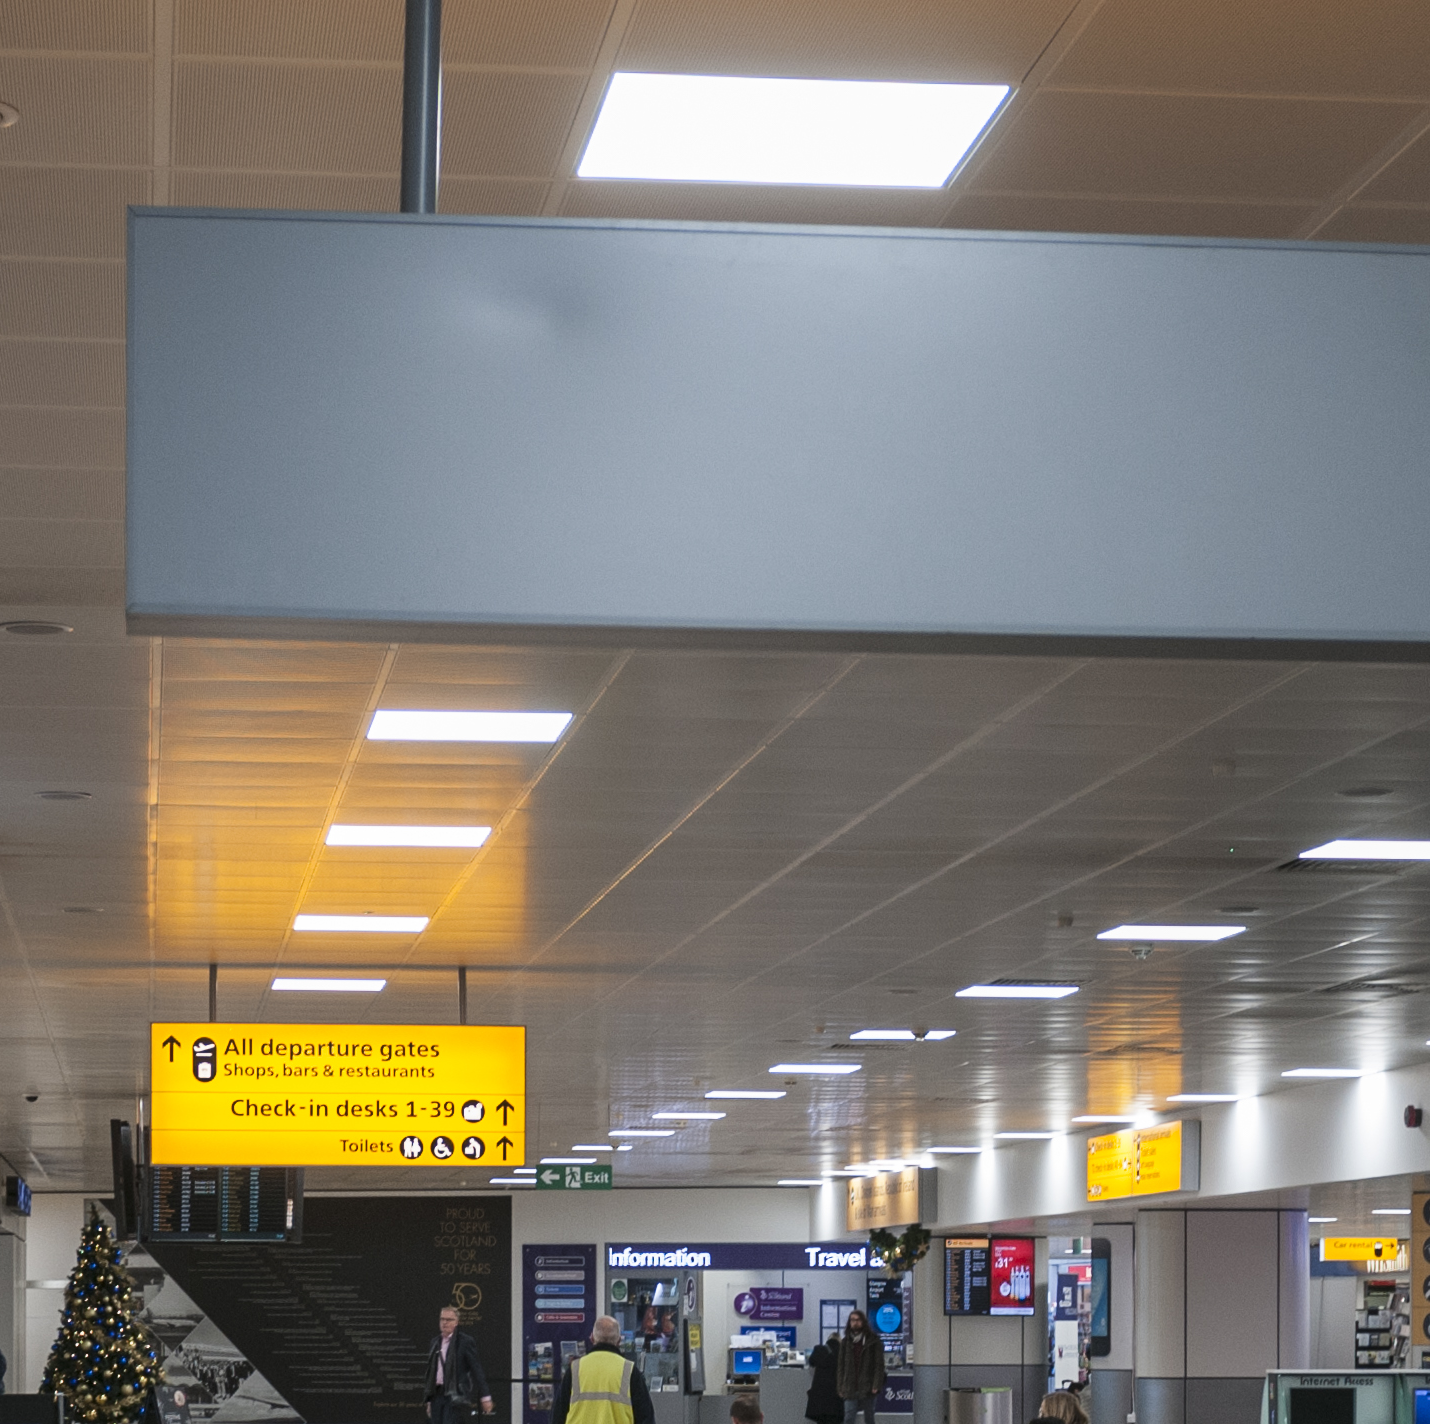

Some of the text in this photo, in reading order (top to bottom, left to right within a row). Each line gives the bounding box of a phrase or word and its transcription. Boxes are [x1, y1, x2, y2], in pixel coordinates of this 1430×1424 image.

[224, 1038, 441, 1062] All departure gates
[223, 1062, 436, 1080] Shops, bars & restaurants
[230, 1098, 456, 1119] Check-in desks 1-39
[339, 1138, 394, 1154] Toilets
[584, 1172, 610, 1184] Exit
[446, 1207, 485, 1220] PROUD
[439, 1221, 491, 1234] TO SERVE
[433, 1235, 497, 1248] SCOTLAND
[1333, 1239, 1373, 1249] Car rental
[454, 1248, 477, 1261] FOR
[608, 1246, 712, 1268] Information
[804, 1246, 866, 1268] Travel
[439, 1262, 491, 1275] 50 YEARS
[1299, 1375, 1375, 1387] Internet Access
